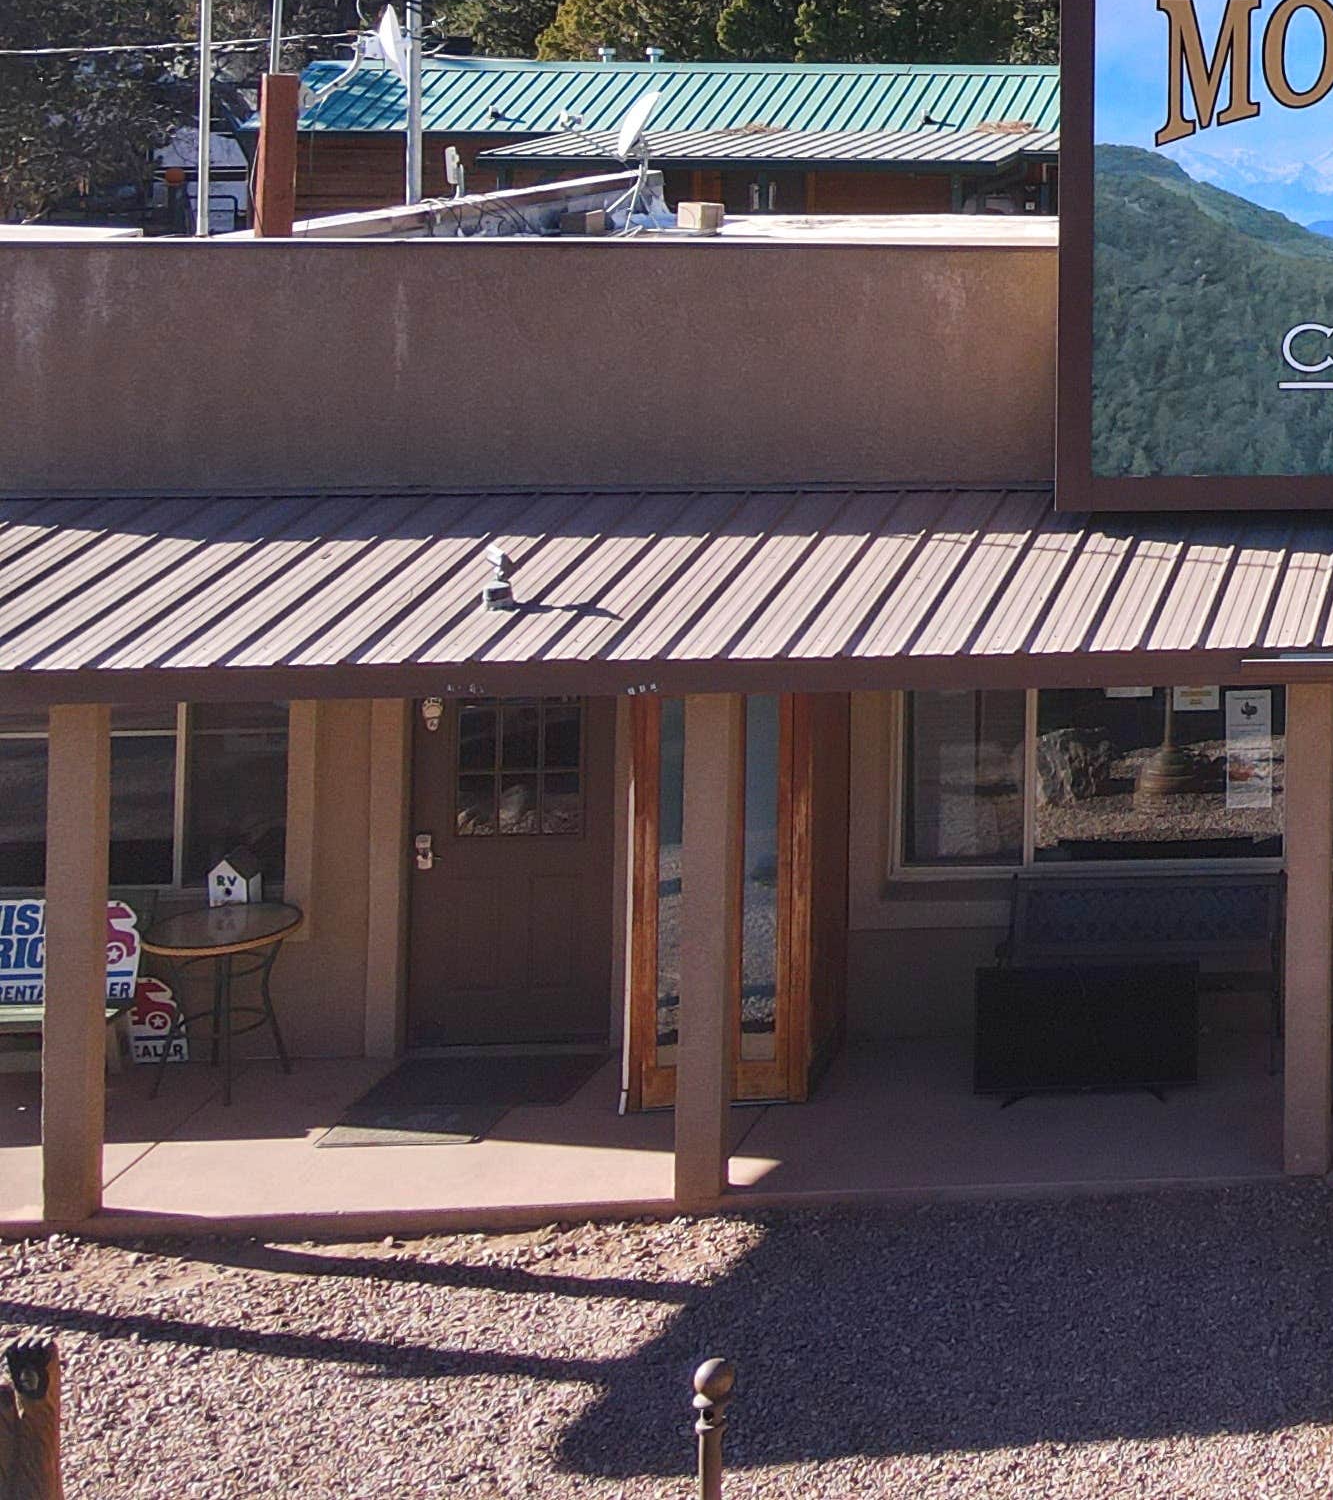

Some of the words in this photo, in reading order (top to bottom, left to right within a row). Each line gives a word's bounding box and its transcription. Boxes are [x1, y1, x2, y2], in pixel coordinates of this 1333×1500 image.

[216, 875, 238, 887] RV
[0, 904, 45, 936] IS
[0, 985, 43, 1002] ENT
[134, 1042, 184, 1060] ALR
